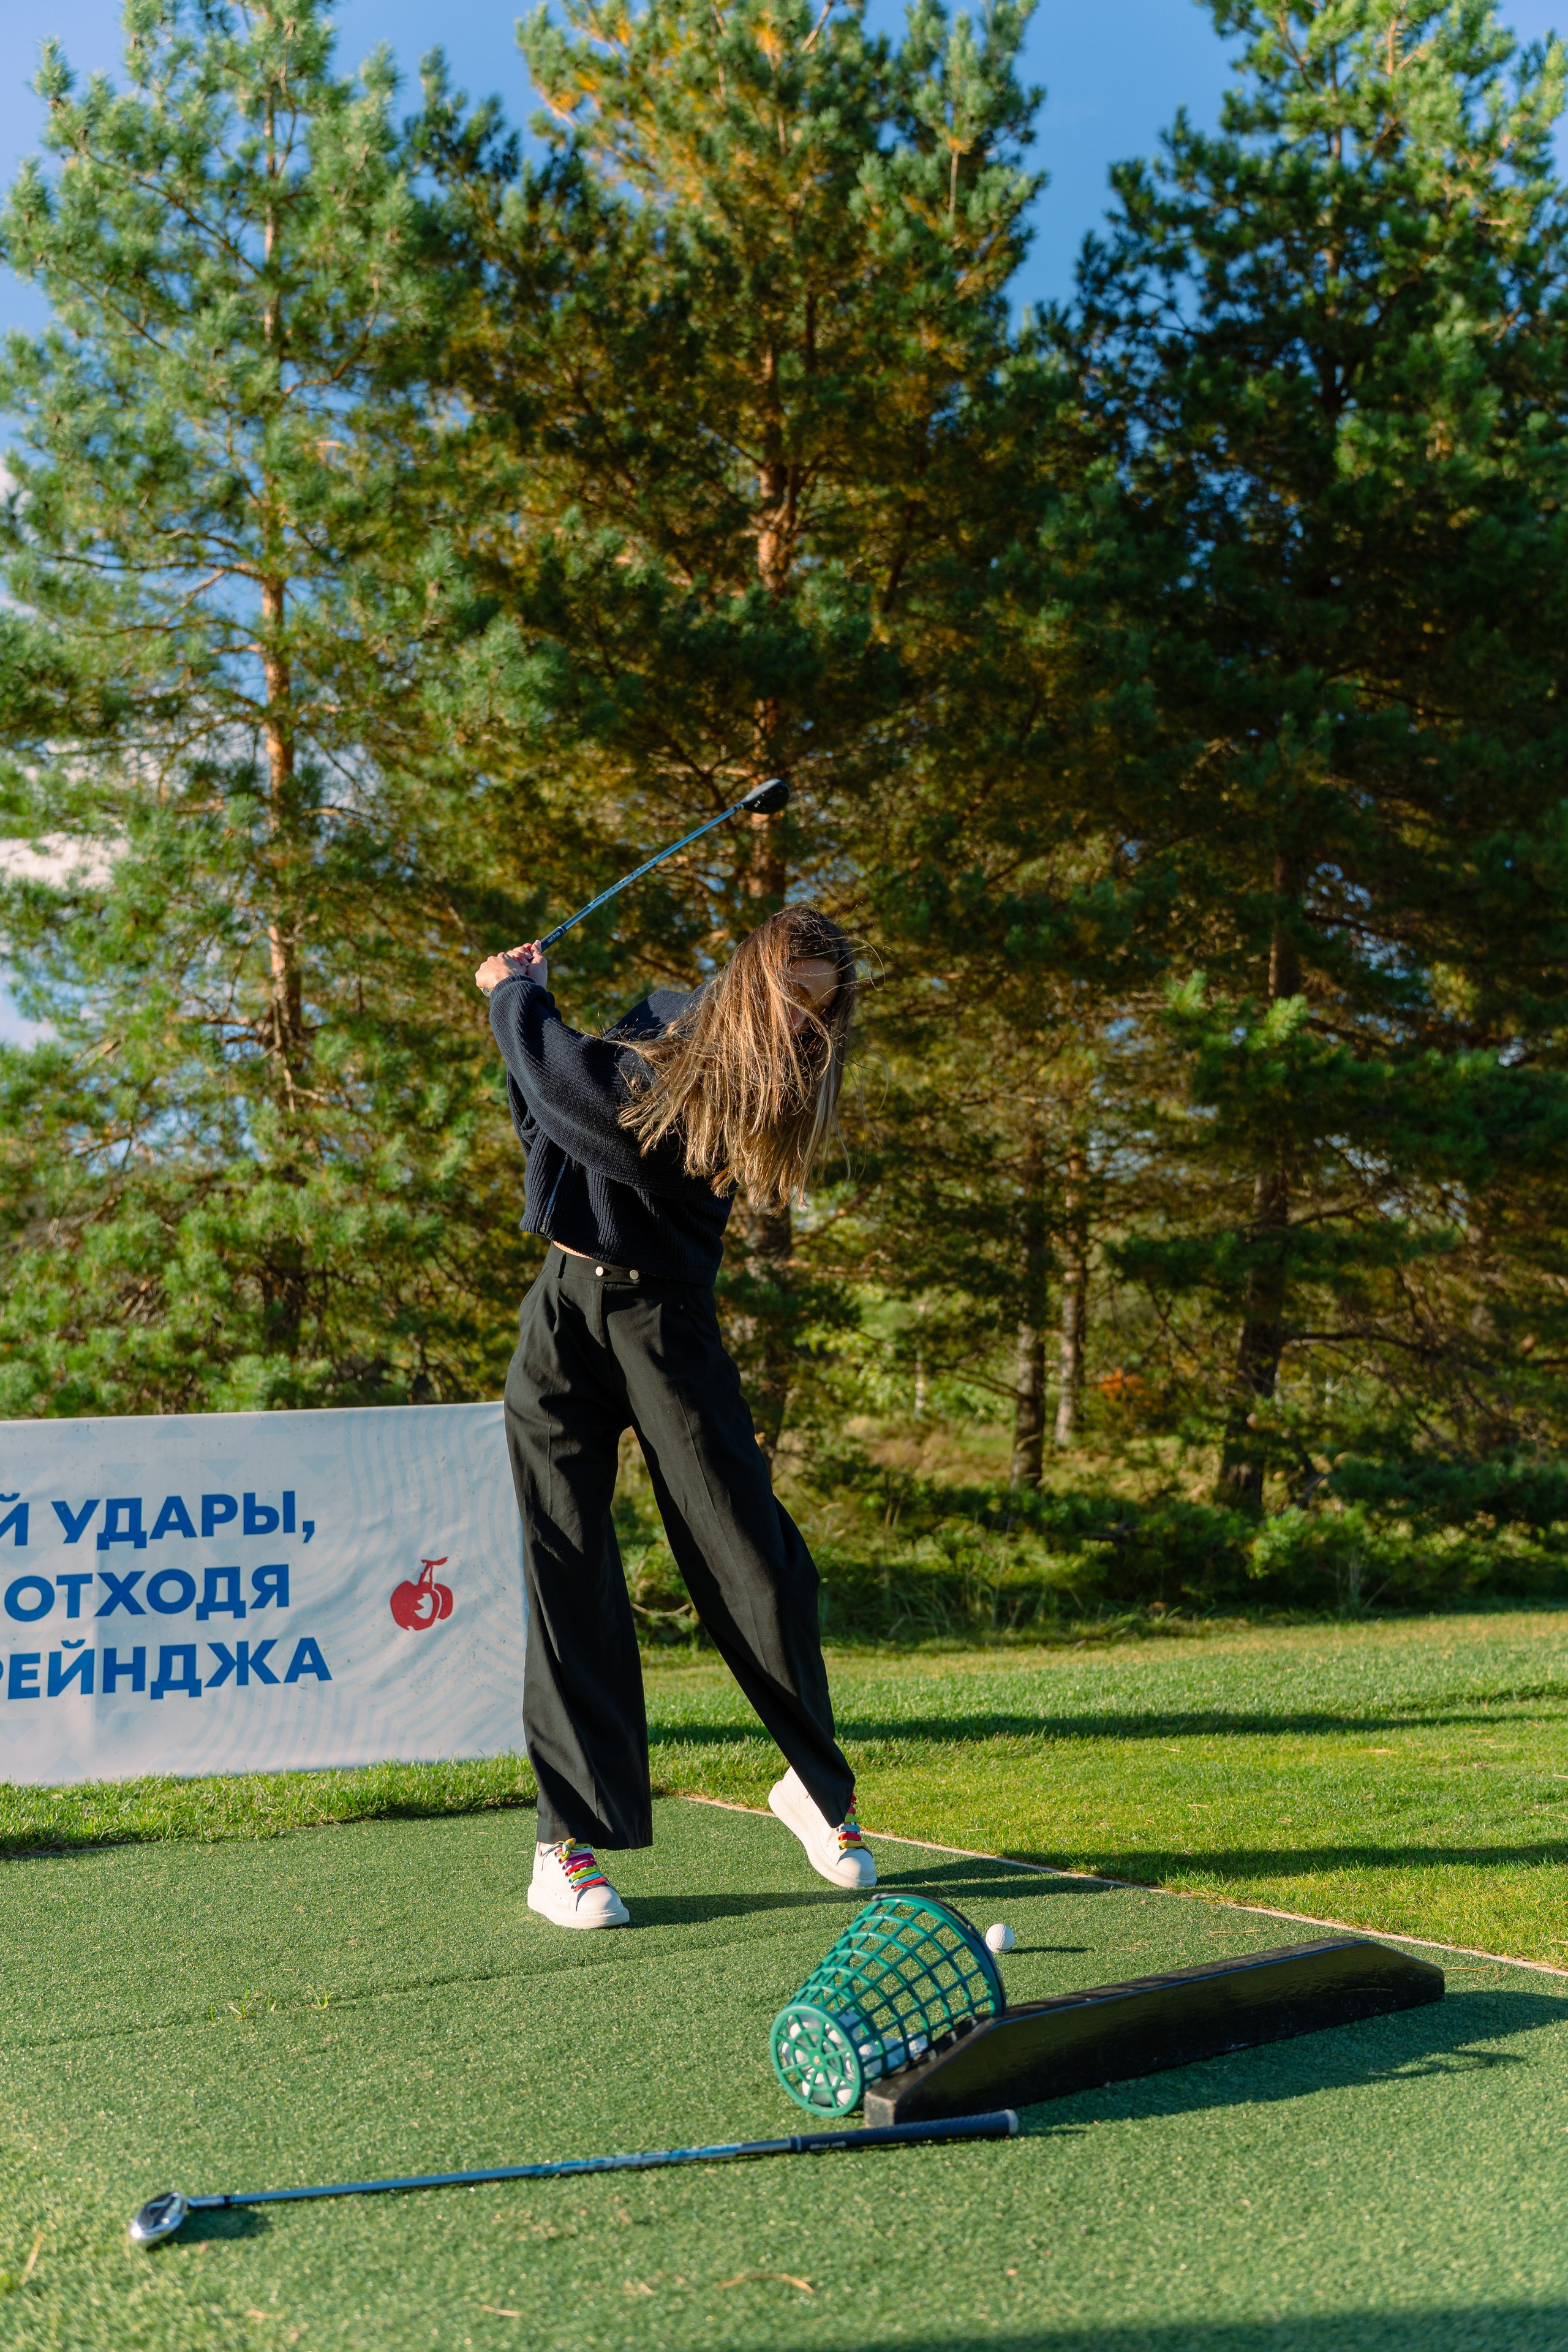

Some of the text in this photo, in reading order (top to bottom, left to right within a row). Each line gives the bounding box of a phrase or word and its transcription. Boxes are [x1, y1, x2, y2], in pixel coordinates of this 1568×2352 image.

[51, 1490, 315, 1551] УДАРЫ,
[4, 1563, 290, 1622] ОТХОДЯ
[0, 1637, 332, 1700] ЕЙНДЖА
